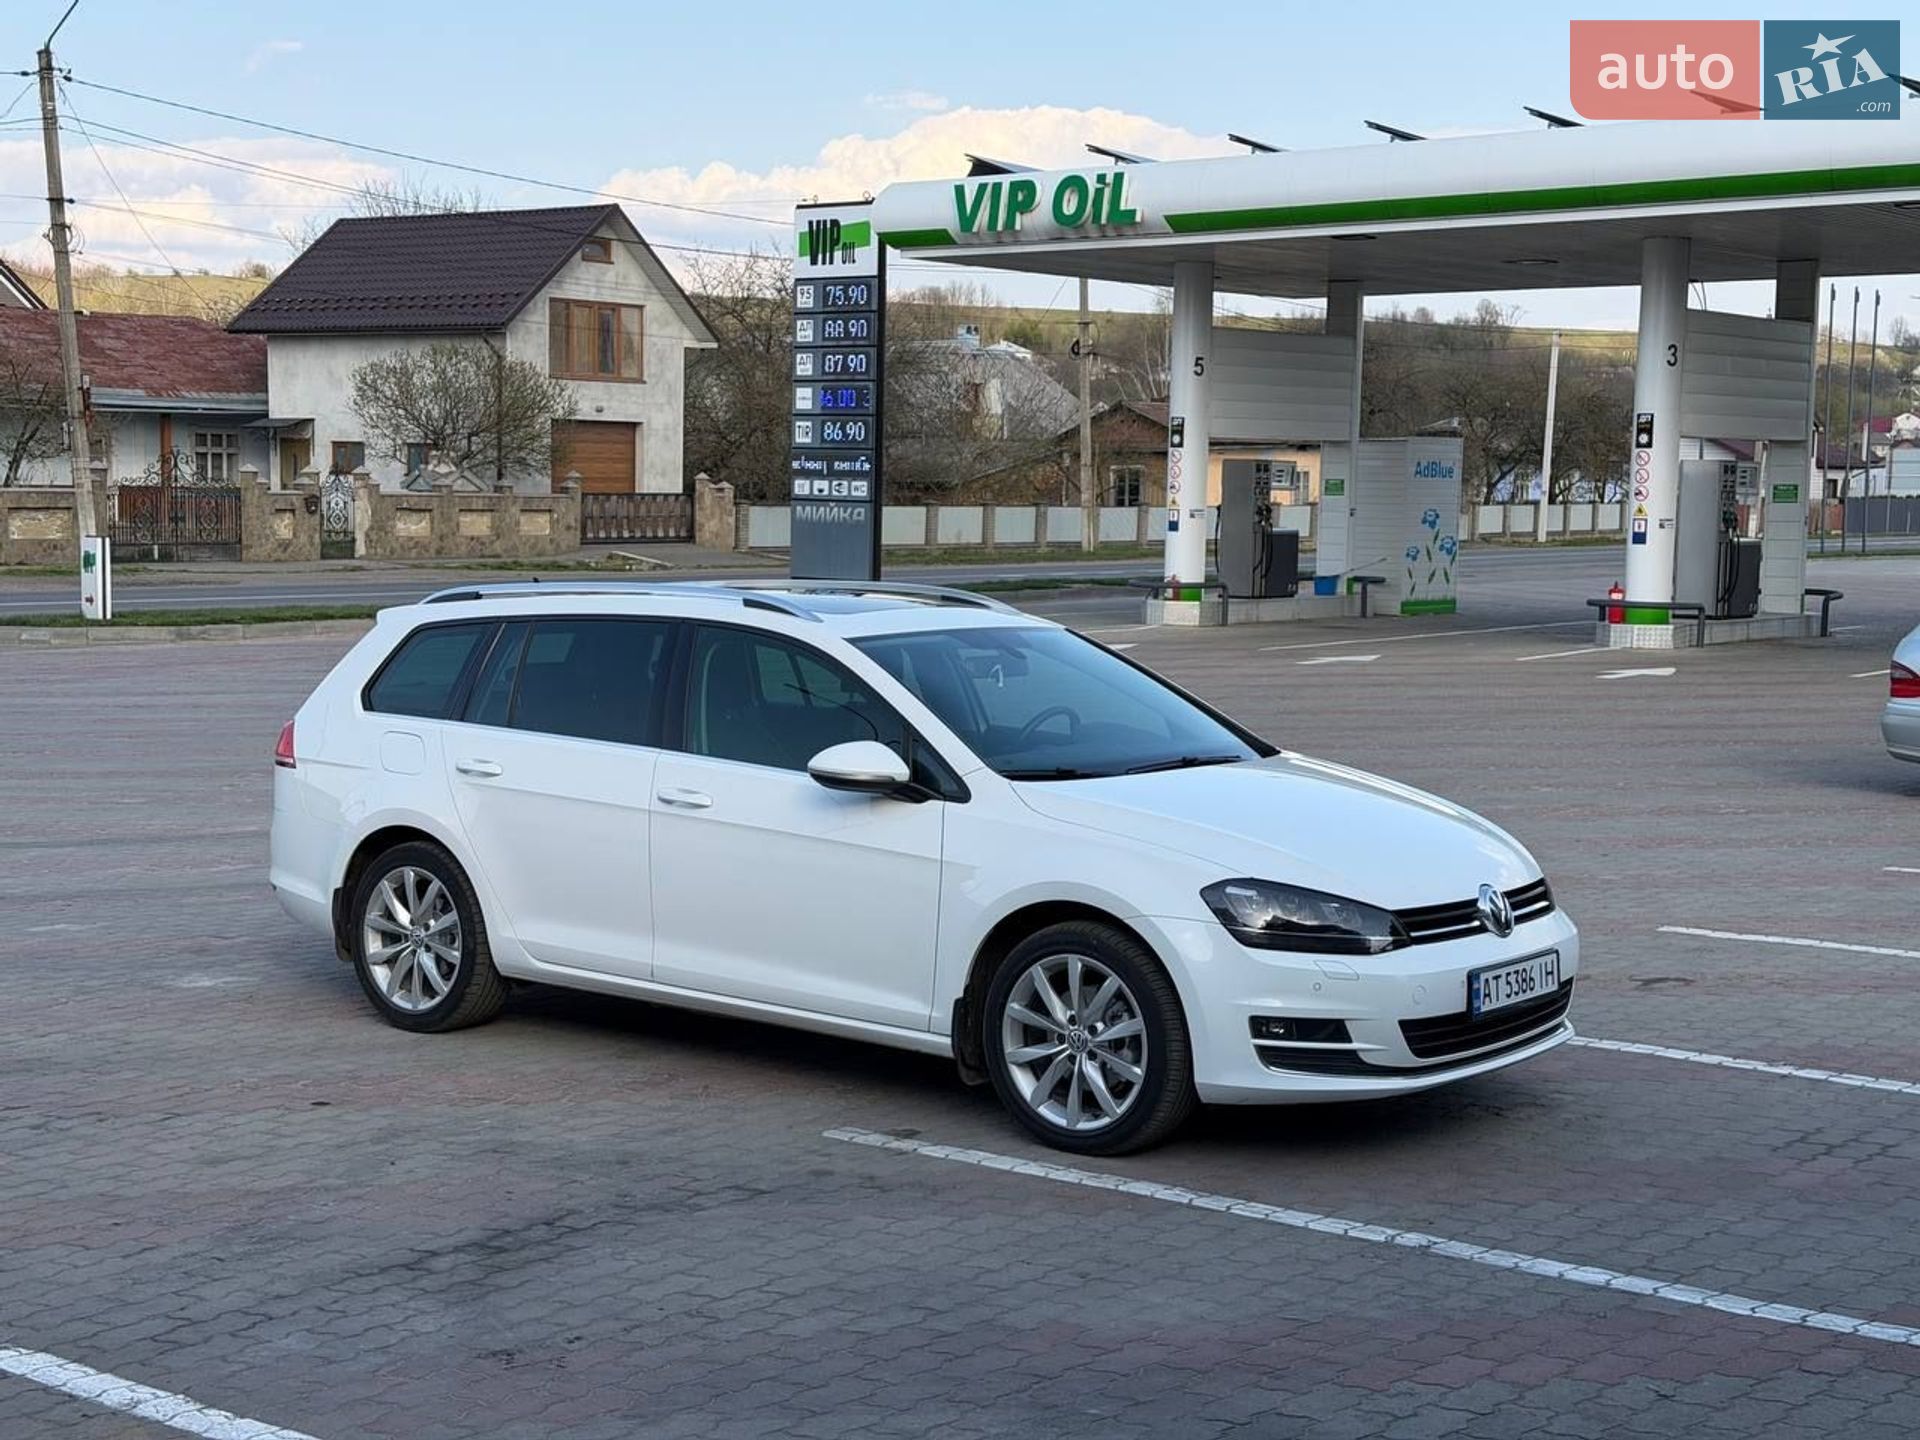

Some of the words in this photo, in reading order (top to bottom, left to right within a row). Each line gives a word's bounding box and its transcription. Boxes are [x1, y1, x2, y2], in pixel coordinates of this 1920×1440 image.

[954, 179, 1039, 234] VIP
[808, 218, 841, 267] VIP
[841, 241, 857, 265] OIL
[799, 288, 812, 300] 95
[826, 285, 867, 306] 75.90
[824, 319, 867, 338] 8890
[1666, 343, 1678, 367] 3
[1193, 356, 1204, 377] 5
[824, 422, 865, 441] 86.90
[1414, 460, 1455, 479] AdBlue
[1482, 974, 1502, 1005] AT
[1505, 965, 1536, 999] 5386
[1539, 959, 1555, 989] IH
